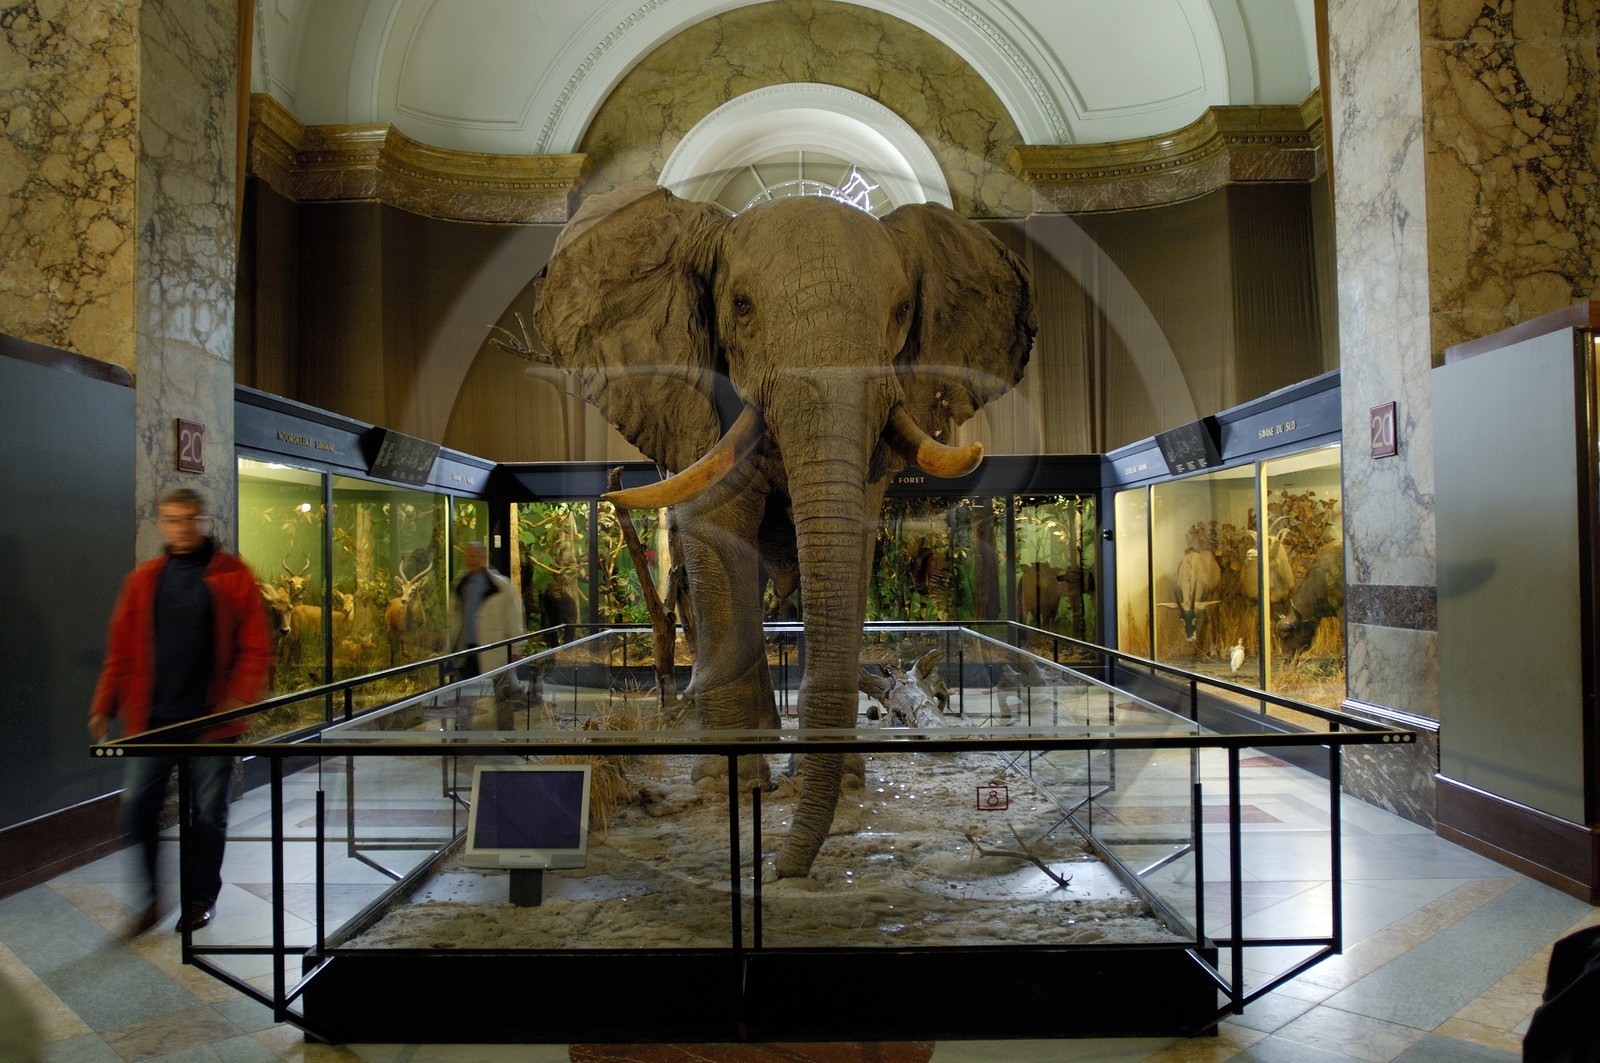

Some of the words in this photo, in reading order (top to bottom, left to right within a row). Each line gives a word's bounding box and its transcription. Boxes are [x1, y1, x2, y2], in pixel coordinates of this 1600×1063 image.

[1372, 412, 1393, 448] 20
[181, 430, 203, 463] 20
[898, 476, 925, 484] FORET
[987, 791, 999, 807] 8
